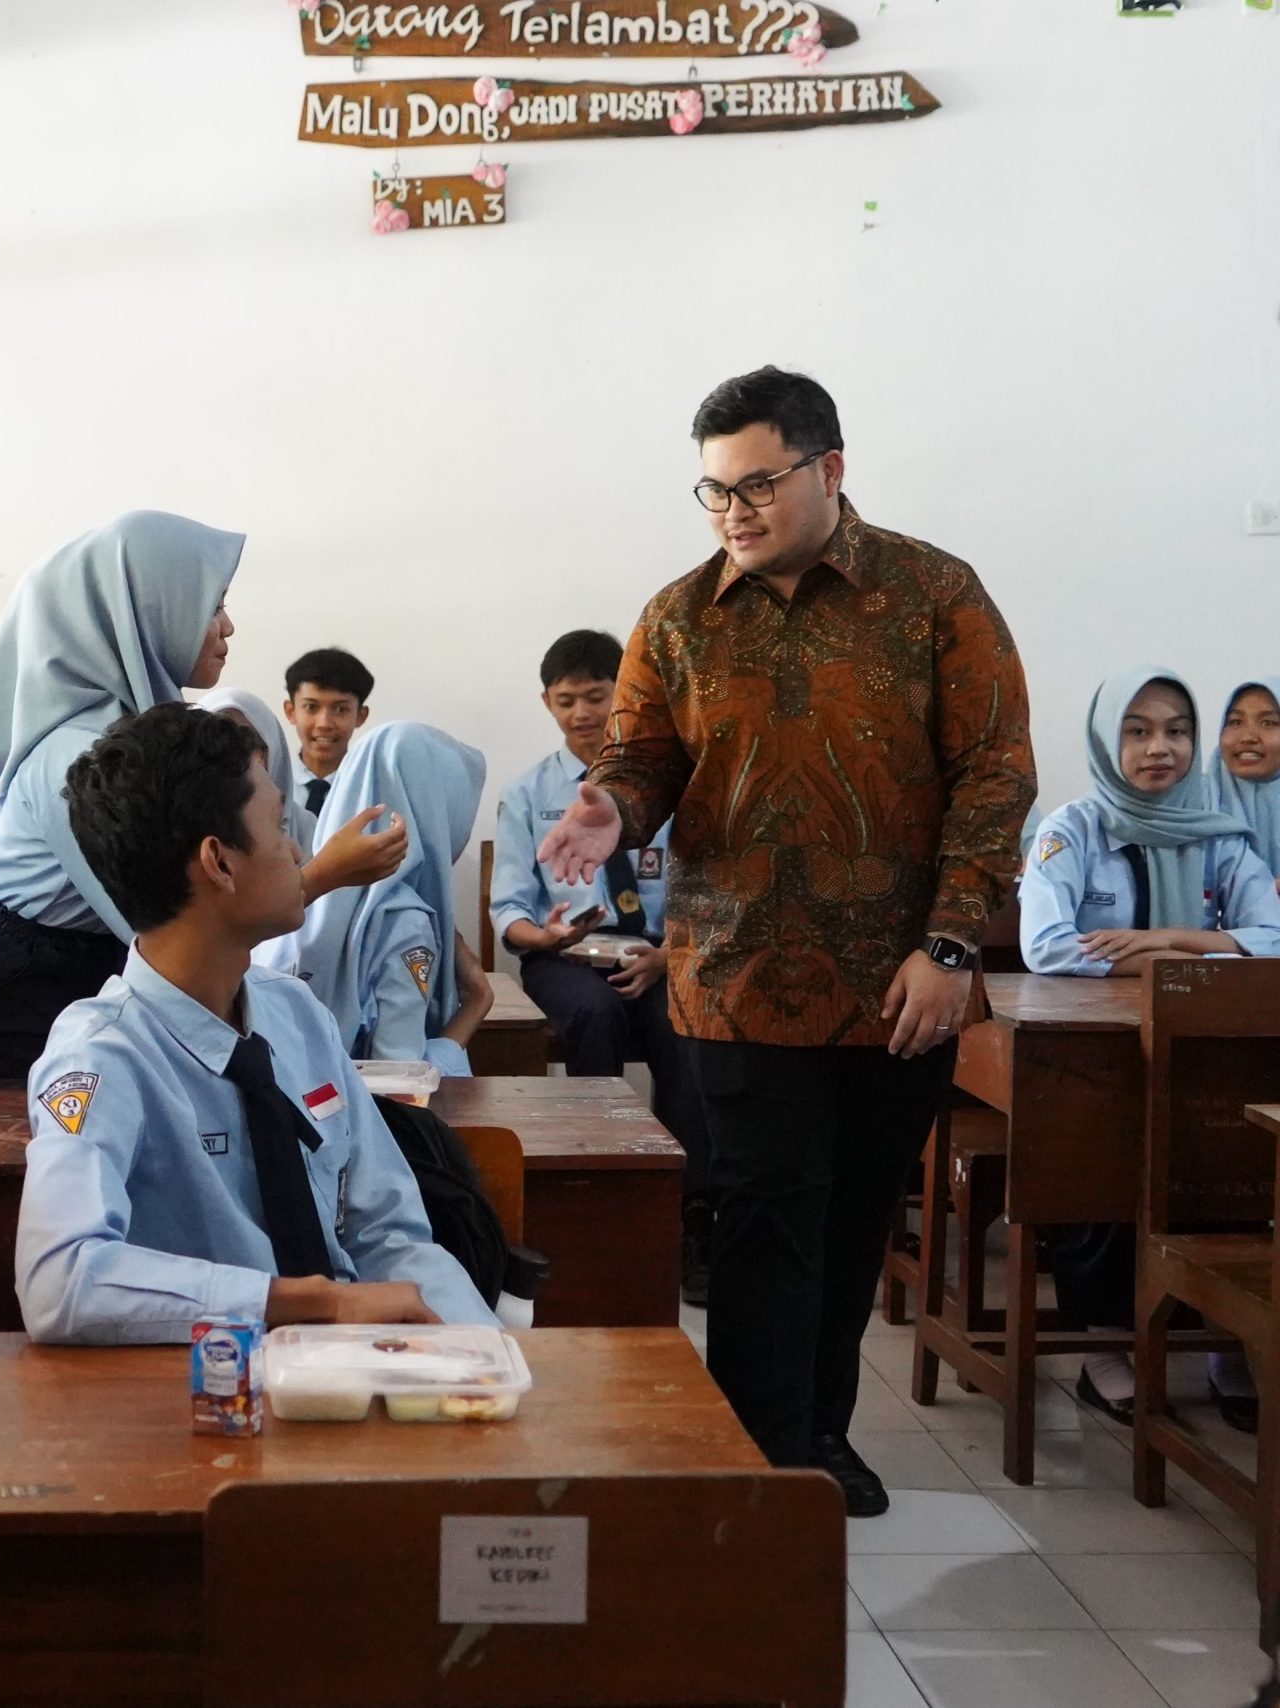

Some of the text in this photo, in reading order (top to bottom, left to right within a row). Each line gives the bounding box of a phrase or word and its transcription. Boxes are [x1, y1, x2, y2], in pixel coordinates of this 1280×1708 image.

[588, 91, 680, 121] PUSAT
[701, 76, 904, 118] PERHATIAN
[423, 193, 504, 227] MIA 3
